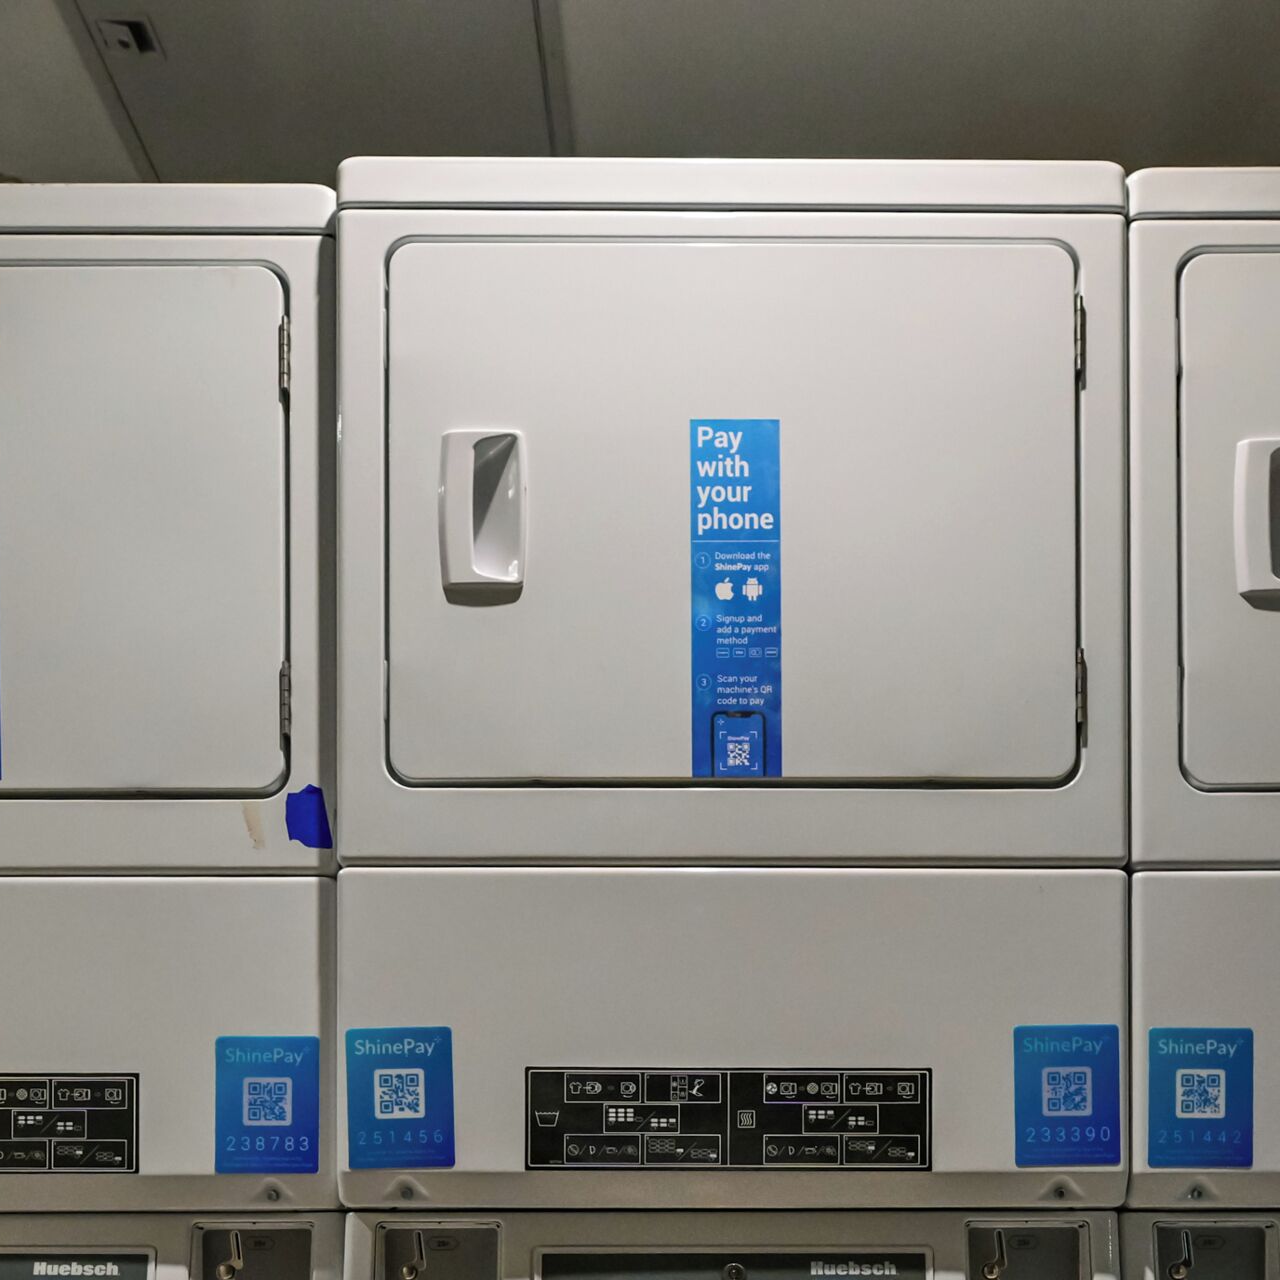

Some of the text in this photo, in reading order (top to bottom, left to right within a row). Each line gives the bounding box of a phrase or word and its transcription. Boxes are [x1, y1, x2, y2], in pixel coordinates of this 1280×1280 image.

[697, 427, 743, 453] Pay
[697, 455, 749, 477] with
[697, 486, 752, 508] your
[698, 507, 773, 535] phone
[715, 563, 769, 572] ShinePay app
[717, 615, 745, 623] Signup
[741, 626, 777, 635] payment
[740, 676, 758, 684] your
[761, 686, 772, 694] QR
[717, 697, 737, 705] code
[750, 698, 764, 706] pay
[354, 1038, 435, 1056] ShinePay
[1023, 1037, 1103, 1055] ShinePay
[1158, 1039, 1238, 1057] ShinePay
[225, 1048, 303, 1066] ShinePay
[33, 1262, 119, 1275] Huebsch
[810, 1261, 897, 1275] Huebsch
